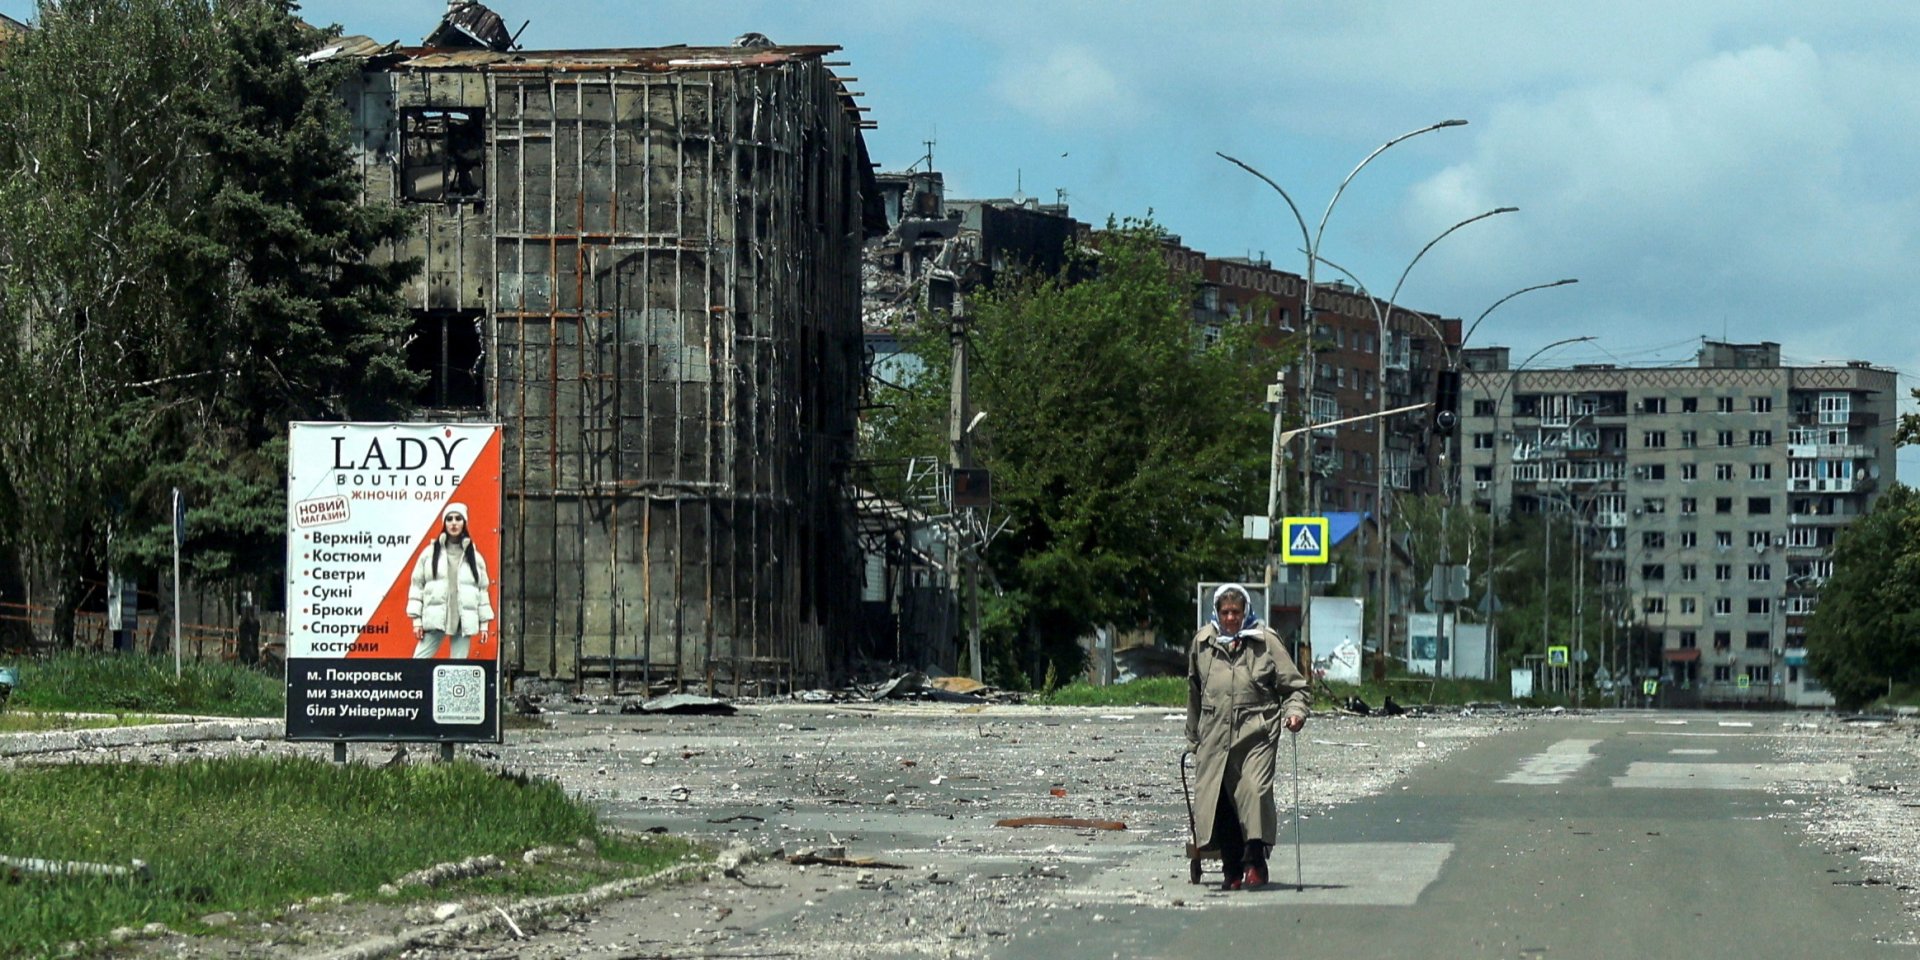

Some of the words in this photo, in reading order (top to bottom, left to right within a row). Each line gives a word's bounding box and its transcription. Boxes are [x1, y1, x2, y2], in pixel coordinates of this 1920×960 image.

[331, 429, 468, 470] LADY
[337, 475, 460, 486] BOUTIQUE
[351, 489, 408, 500] ЖІНОЧІЙ
[415, 490, 446, 502] ОДЯГ
[299, 498, 345, 515] НОВИЙ
[301, 511, 346, 524] МАГАЗИН
[313, 531, 372, 547] Верхній
[378, 534, 411, 545] одяг
[313, 550, 382, 562] Костюми
[312, 568, 365, 582] Светри
[312, 586, 352, 601] Сукні
[312, 604, 363, 619] Брюки
[311, 621, 389, 636] Спортивні
[311, 642, 378, 652] костюми
[307, 671, 322, 680] м.
[326, 669, 402, 684] Покровськ
[307, 690, 326, 698] ми
[331, 690, 423, 702] знаходимося
[307, 705, 335, 716] біля
[339, 705, 419, 720] Універмагу
